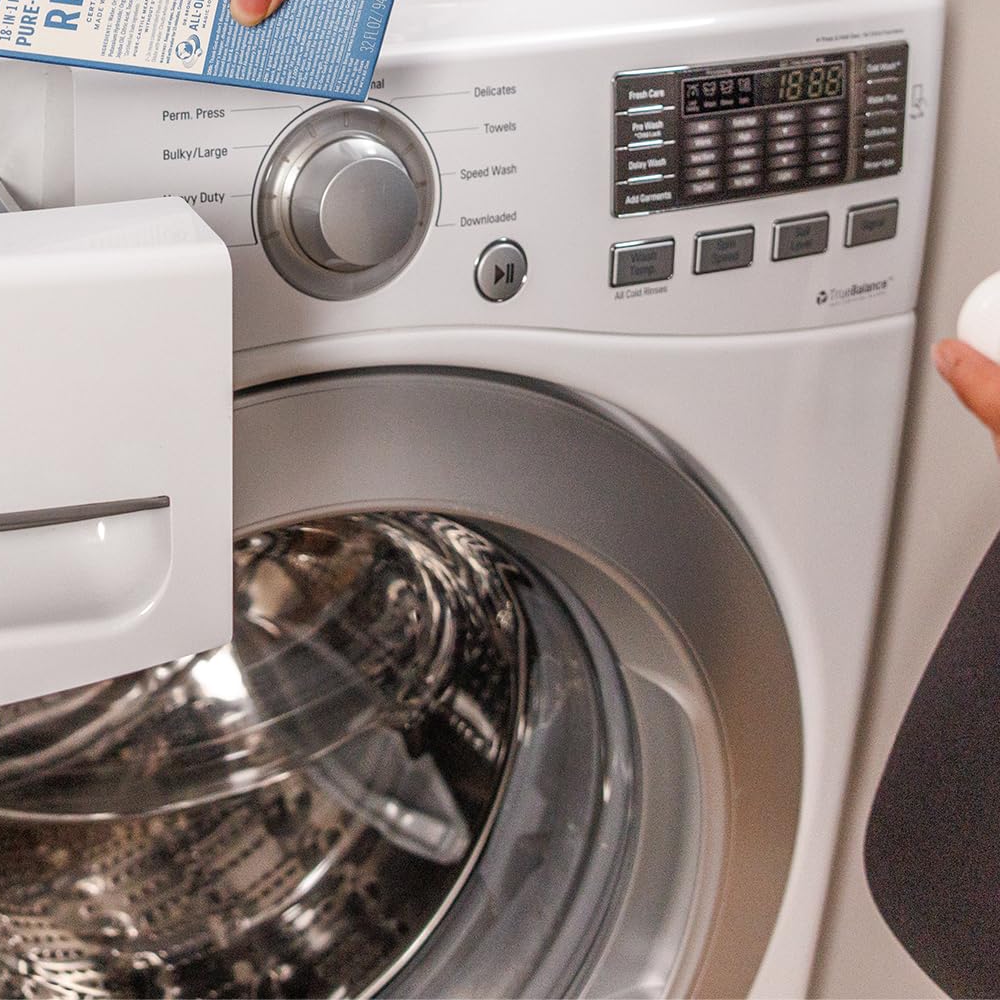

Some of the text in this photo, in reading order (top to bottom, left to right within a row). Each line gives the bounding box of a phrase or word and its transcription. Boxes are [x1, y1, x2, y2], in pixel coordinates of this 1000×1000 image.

[93, 6, 104, 30] MADE
[474, 85, 517, 98] Delicates
[162, 108, 225, 121] Perm. Press
[484, 122, 517, 133] Towels
[163, 147, 228, 161] Bulky/Large
[460, 164, 517, 181] Speed Wash
[200, 192, 225, 204] Duty
[460, 211, 517, 227] Downloaded
